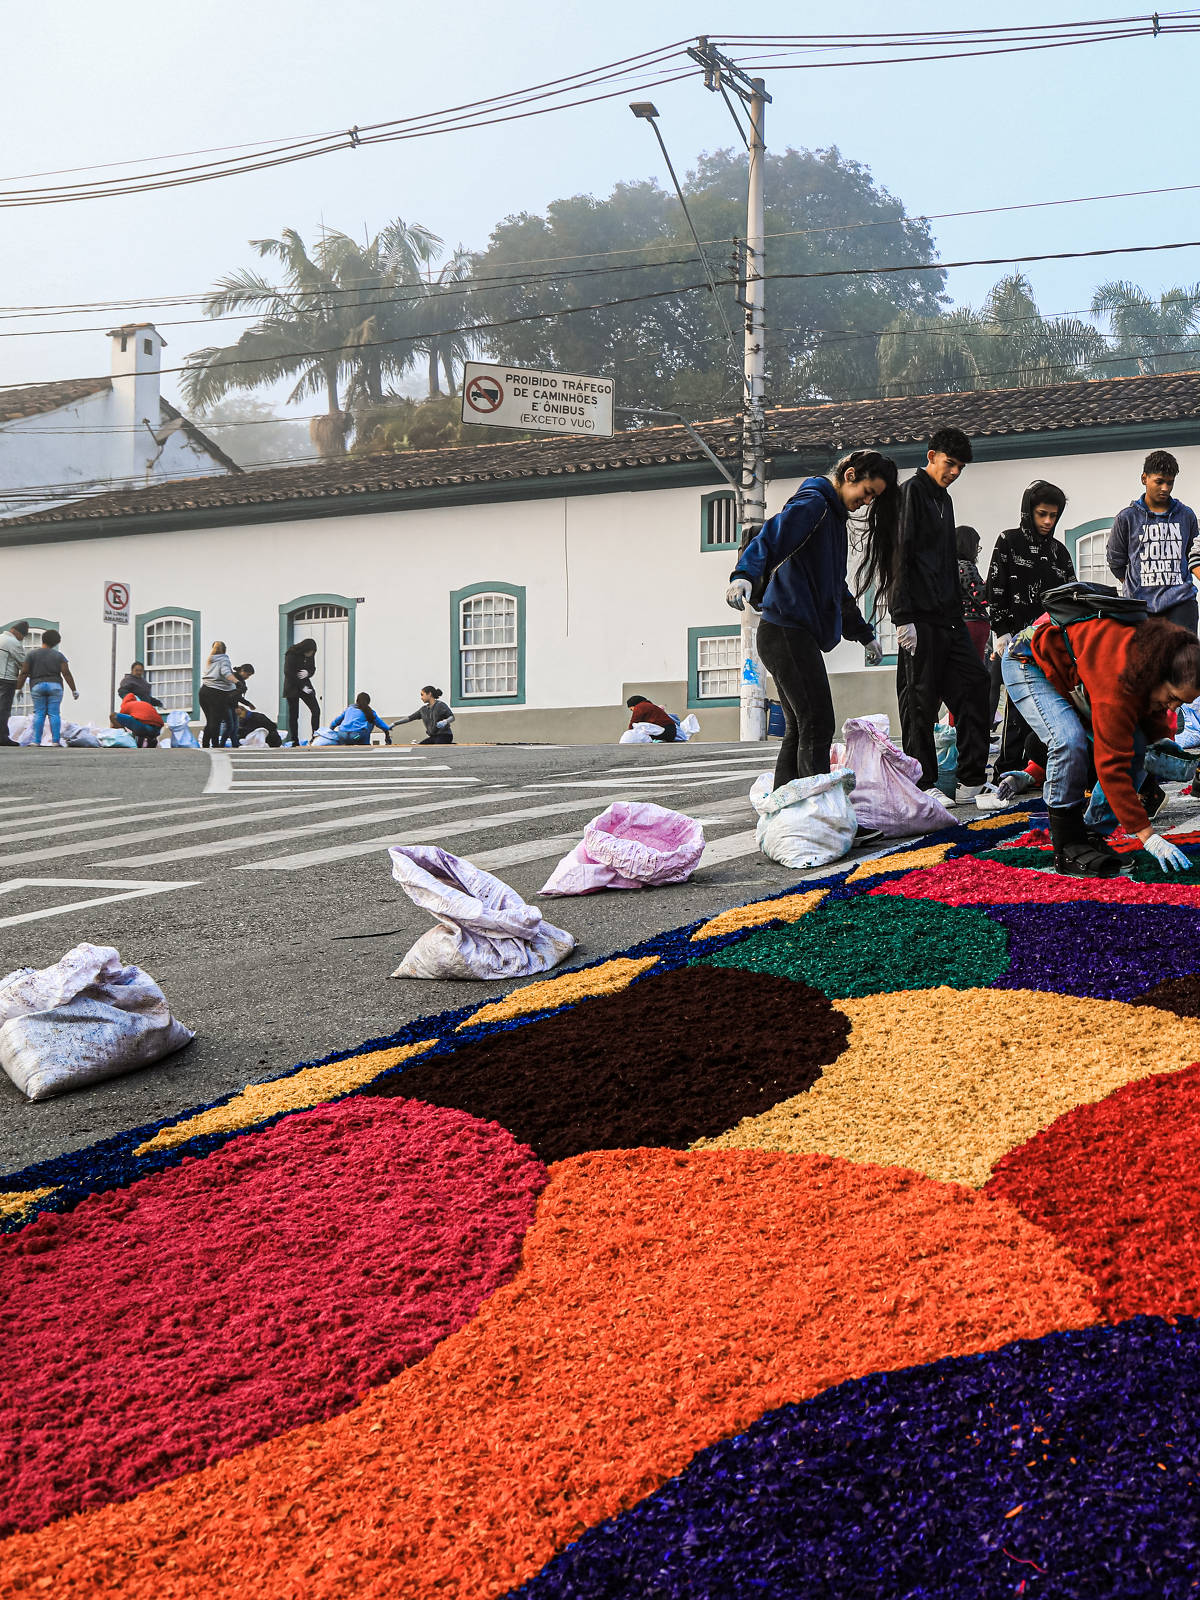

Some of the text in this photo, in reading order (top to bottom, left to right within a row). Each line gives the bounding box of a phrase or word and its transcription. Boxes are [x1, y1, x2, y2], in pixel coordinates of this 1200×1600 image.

[505, 373, 612, 395] PROIBIDO TRÁFEGO
[513, 388, 598, 405] DE CAMINHÕES
[531, 400, 585, 416] E ÔNIBUS
[520, 413, 595, 430] (EXCETO VUC)
[1139, 522, 1182, 542] JOHN
[1140, 541, 1183, 560] JOHN
[1140, 560, 1181, 574] MADE IN
[1140, 573, 1184, 587] HEAVEN
